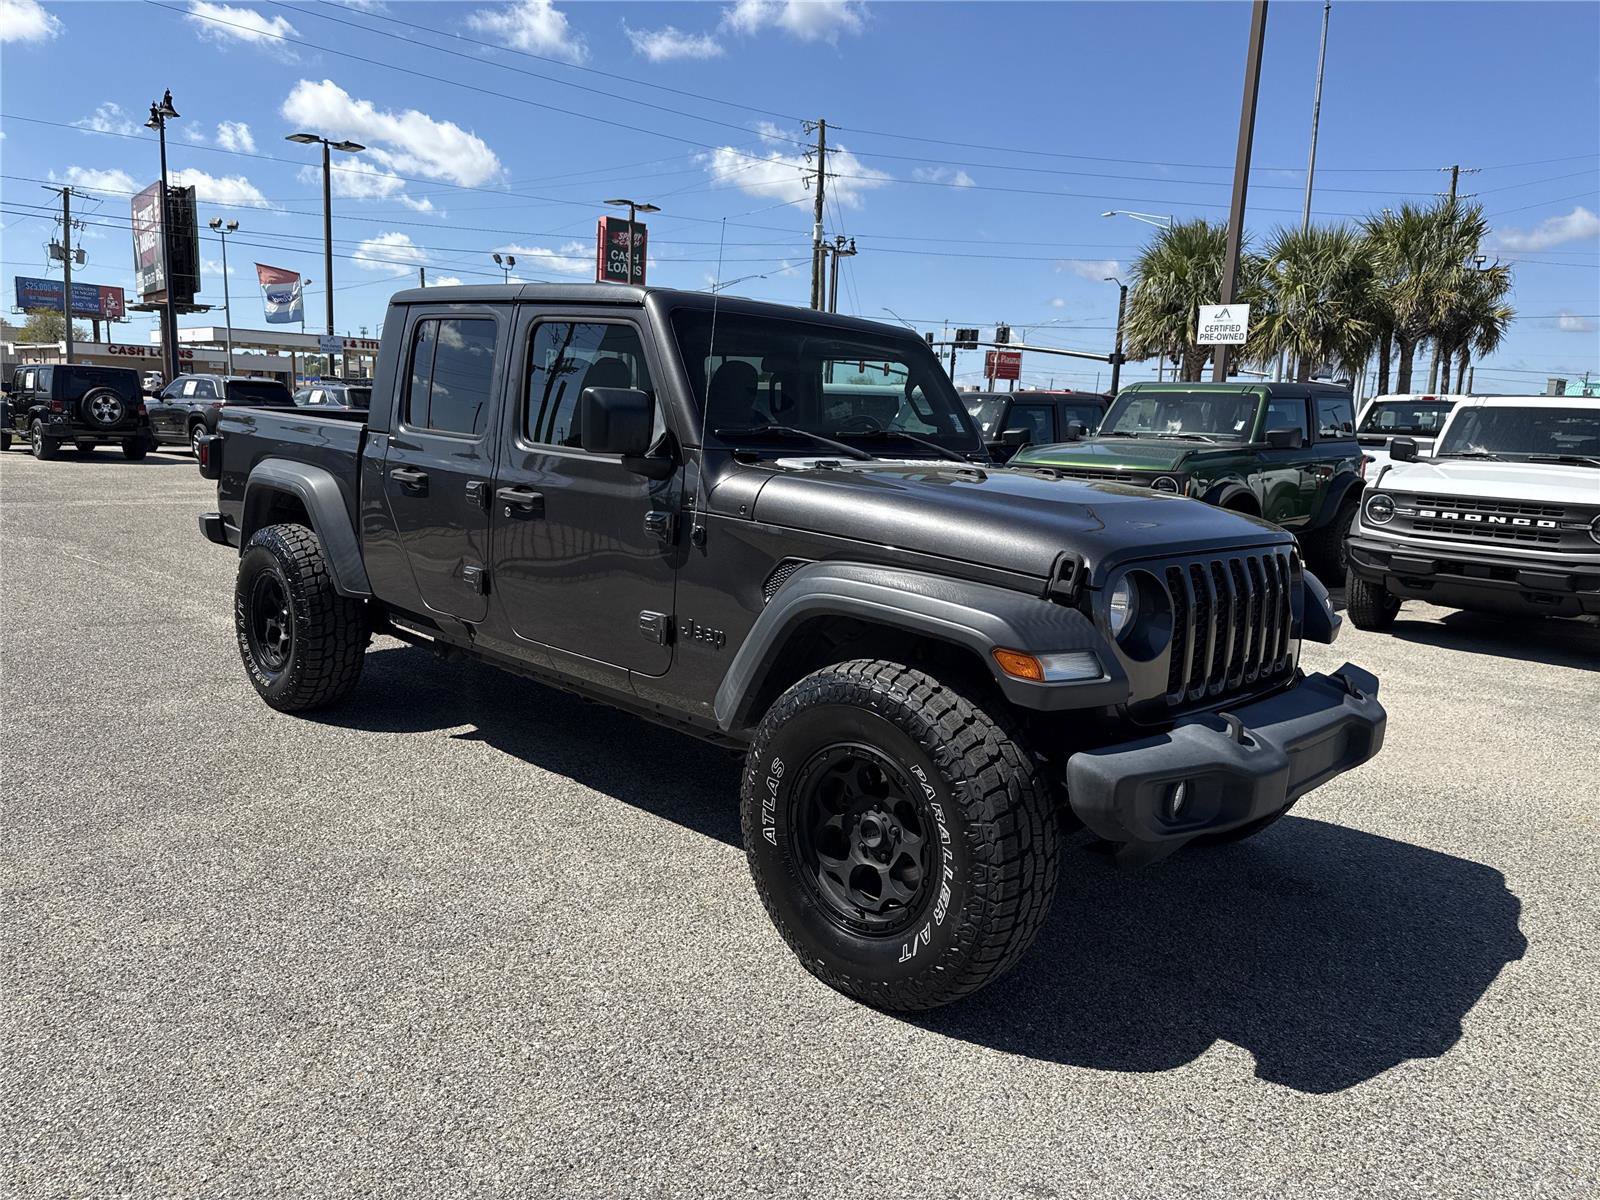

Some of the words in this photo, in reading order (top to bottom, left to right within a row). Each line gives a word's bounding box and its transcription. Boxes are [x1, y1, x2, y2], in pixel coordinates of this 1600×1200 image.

[608, 262, 642, 276] LOAS
[108, 345, 145, 356] CASH
[150, 348, 194, 359] LNS
[1419, 509, 1556, 529] BRONCO
[681, 618, 727, 650] Jeep
[762, 757, 785, 846] ATLAS
[910, 764, 953, 926] PARALLER
[899, 922, 931, 963] A/T
